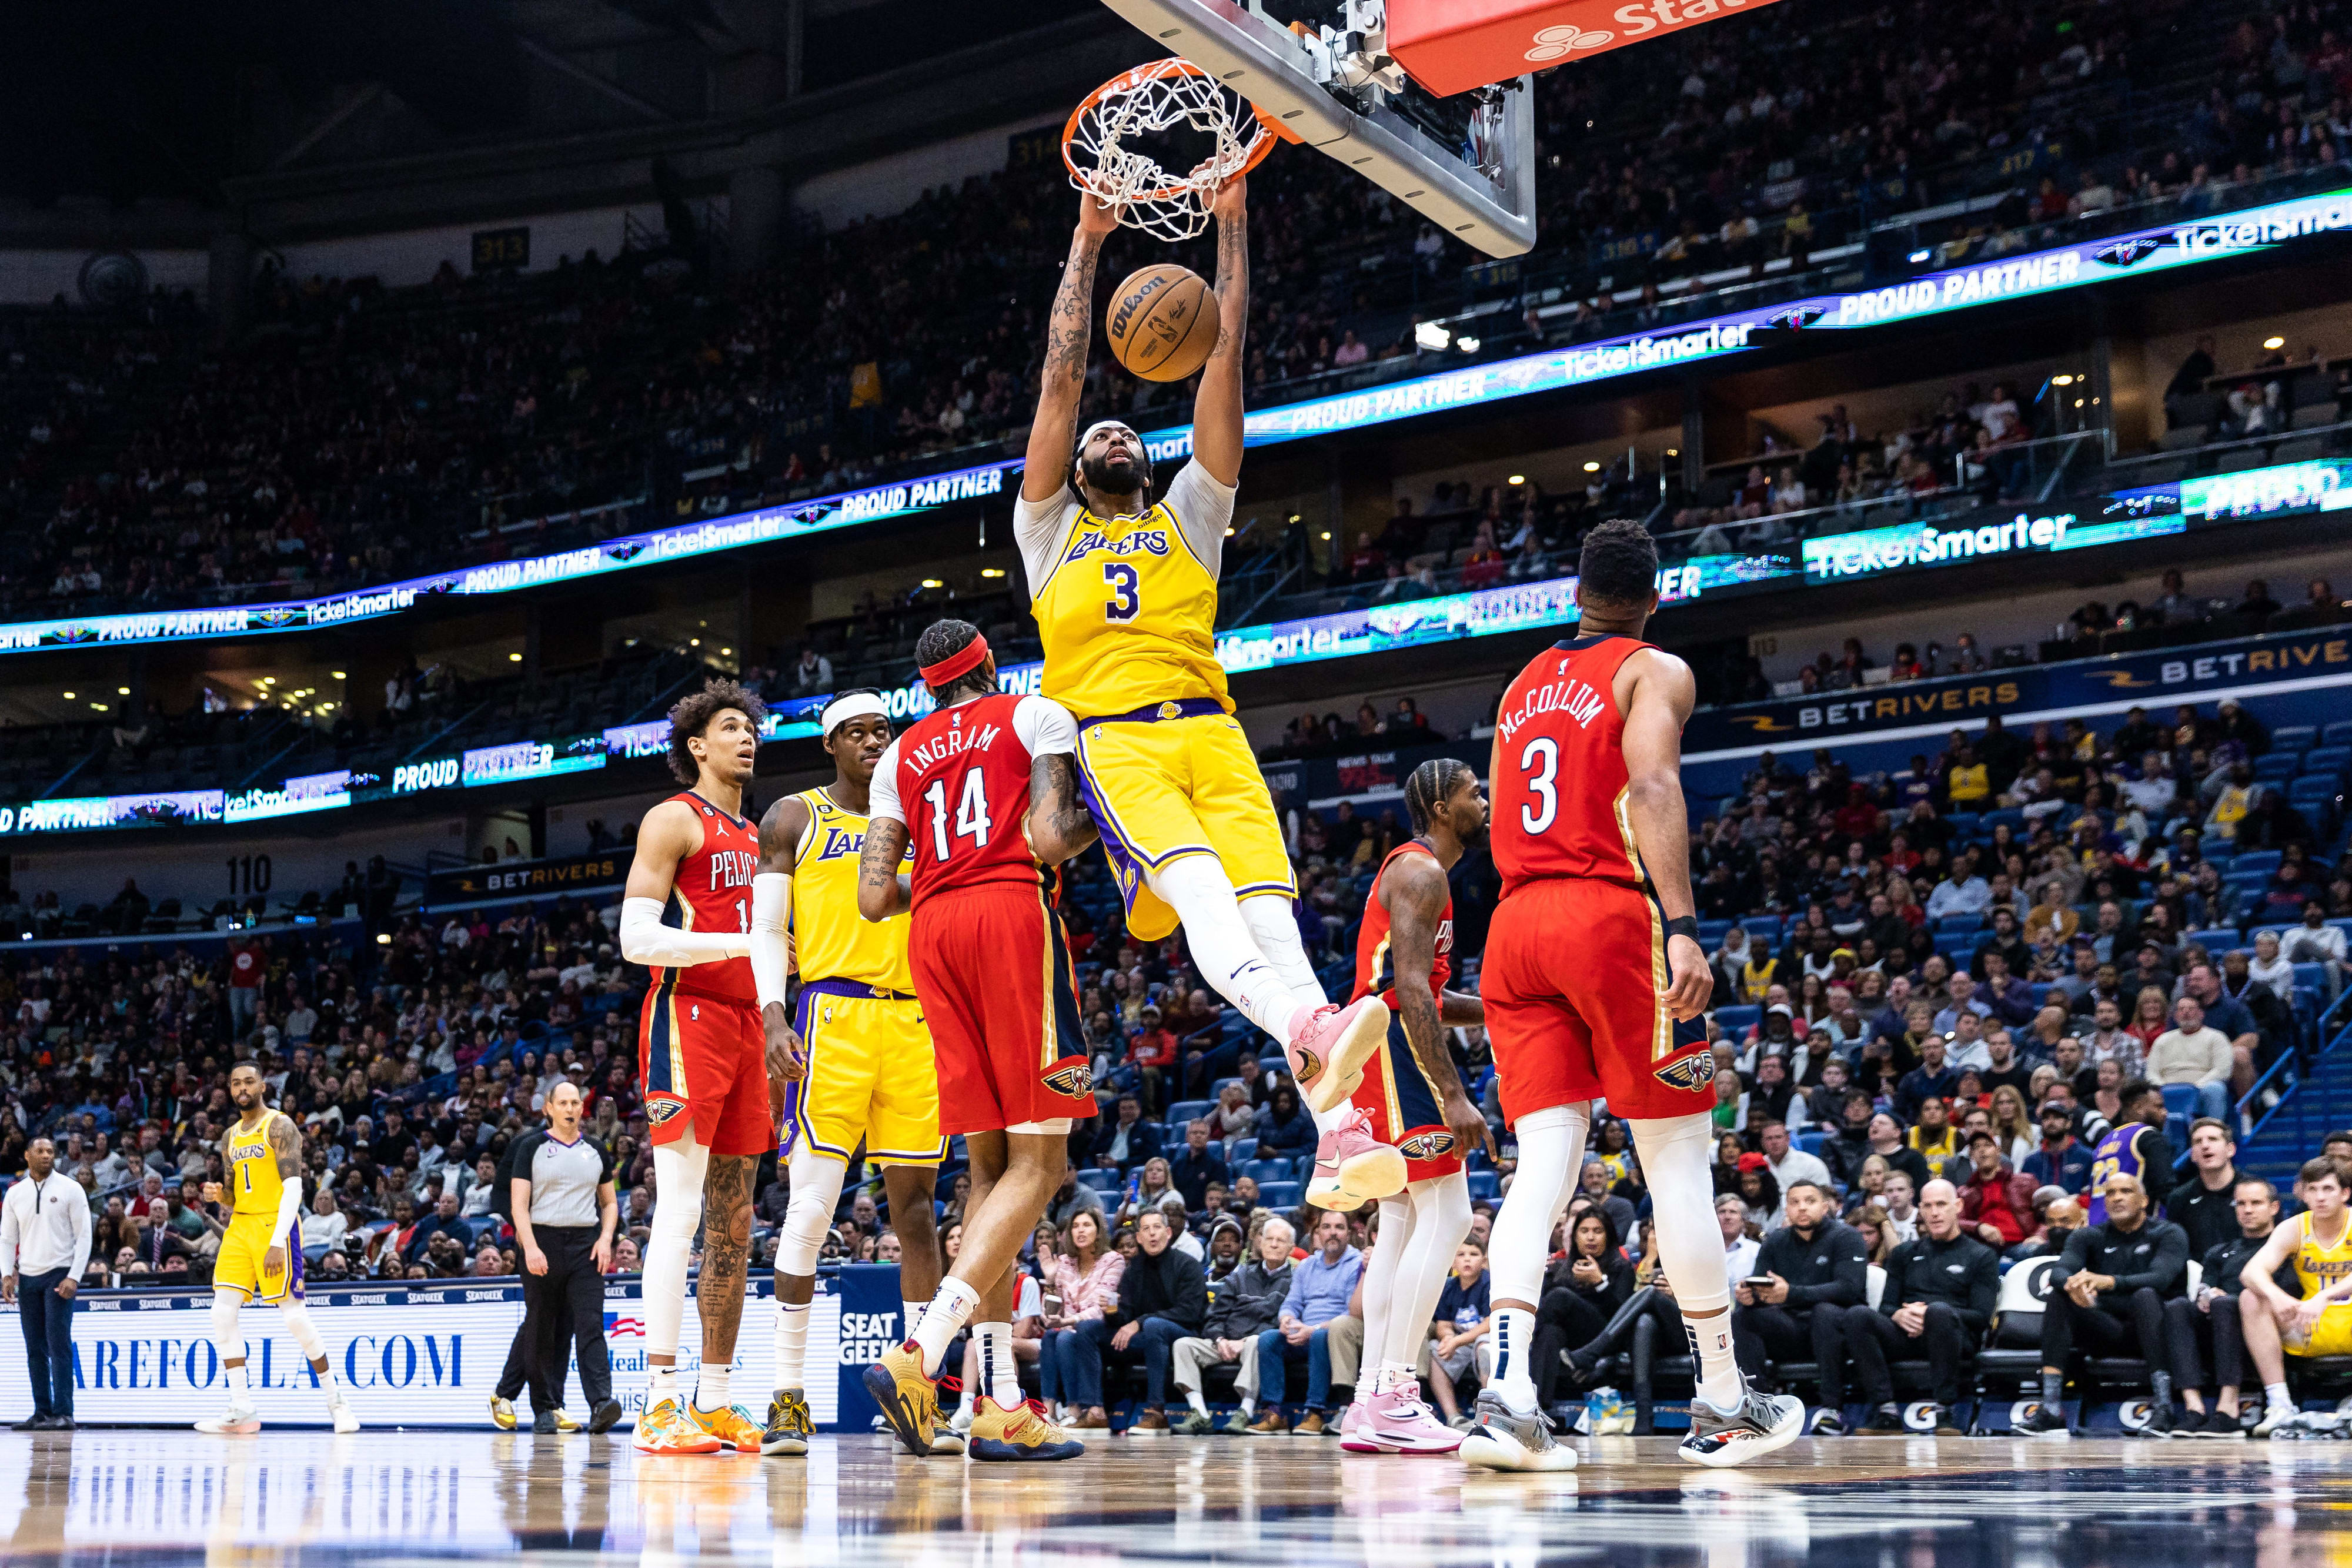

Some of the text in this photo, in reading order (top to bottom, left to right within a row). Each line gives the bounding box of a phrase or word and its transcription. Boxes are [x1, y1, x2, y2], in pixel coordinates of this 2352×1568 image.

[479, 236, 523, 263] 313
[1111, 276, 1168, 339] Wilson
[1560, 322, 1756, 379] TicketSmarter
[1840, 280, 1937, 325] PROUD
[1942, 250, 2082, 303] PARTNER
[1292, 399, 1371, 432] PROUD
[1376, 374, 1485, 414] PARTNER
[1138, 513, 1162, 530] bibigo
[98, 619, 159, 641] PROUD
[164, 610, 248, 637] PARTNER
[305, 587, 418, 626] TicketSmarter
[465, 564, 521, 594] PROUD
[524, 548, 602, 581] PARTNER
[651, 515, 785, 557] TicketSmarter
[840, 490, 906, 521] PROUD
[910, 470, 1003, 507] PARTNER
[1064, 530, 1170, 567] LAKERS
[1103, 563, 1140, 625] 3
[1798, 638, 2350, 728] BETRIVERS BETRIVE
[1157, 704, 1183, 717] LAKERS
[1499, 679, 1605, 744] McCOLLUM
[905, 724, 1001, 777] INGRAM
[18, 798, 117, 831] PARTNER
[392, 758, 459, 794] PROUD
[1520, 736, 1559, 836] 3
[703, 807, 714, 817] 6
[923, 765, 992, 862] 14
[226, 854, 272, 894] 110
[487, 860, 614, 891] BETRIVERS
[243, 1162, 252, 1193] 1
[89, 1299, 121, 1311] SEATGEEK
[139, 1298, 172, 1309] SEATGEEK
[350, 1293, 387, 1305] SEATGEEK
[407, 1291, 445, 1305] SEATGEEK
[466, 1289, 504, 1302] SEATGEEK
[841, 1312, 898, 1339] SEAT
[840, 1339, 900, 1366] GEEK
